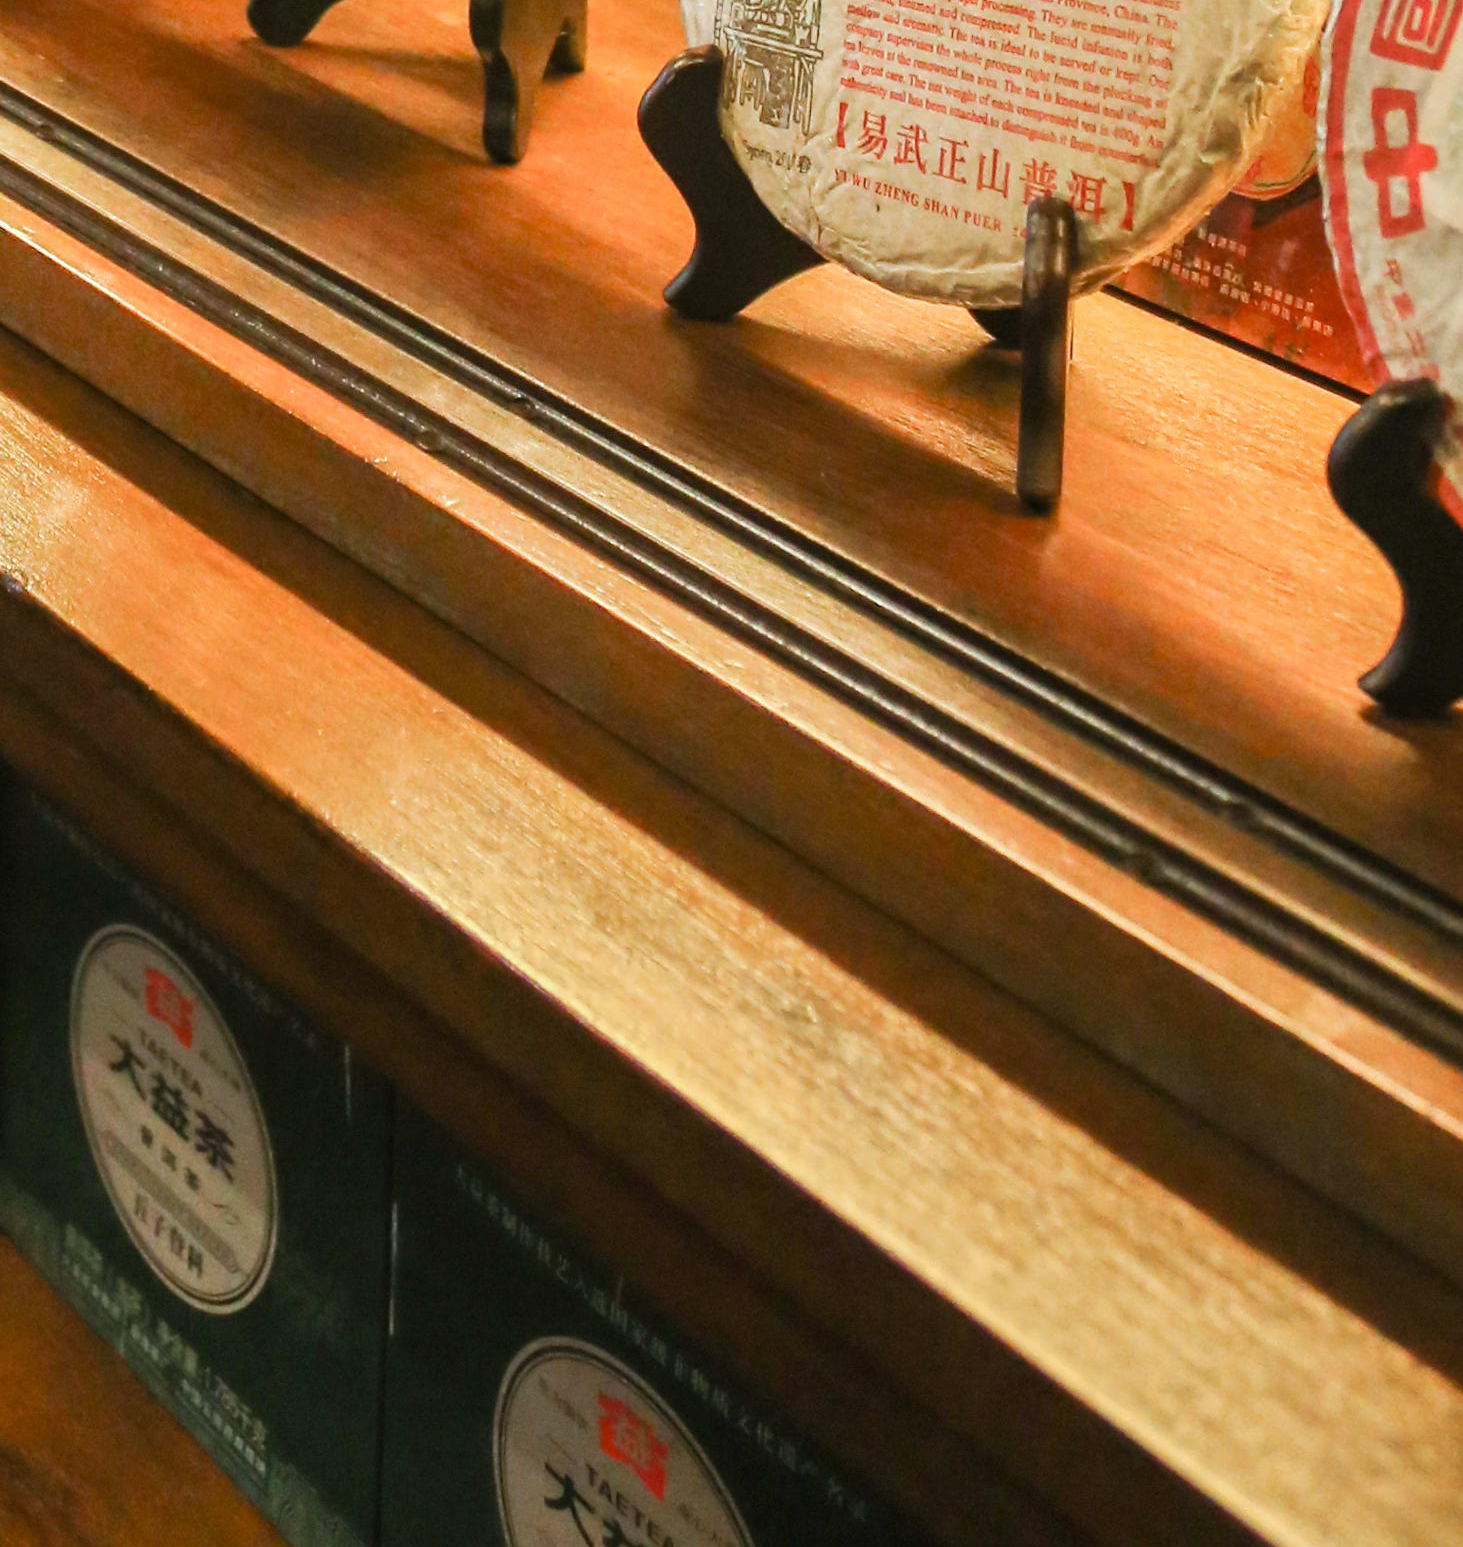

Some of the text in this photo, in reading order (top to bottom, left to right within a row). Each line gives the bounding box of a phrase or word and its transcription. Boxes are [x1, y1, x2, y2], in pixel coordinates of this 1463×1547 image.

[875, 181, 920, 207] ZHENG
[924, 195, 959, 221] SHAN
[964, 210, 1002, 233] PUER
[108, 1032, 236, 1186] 大益茶
